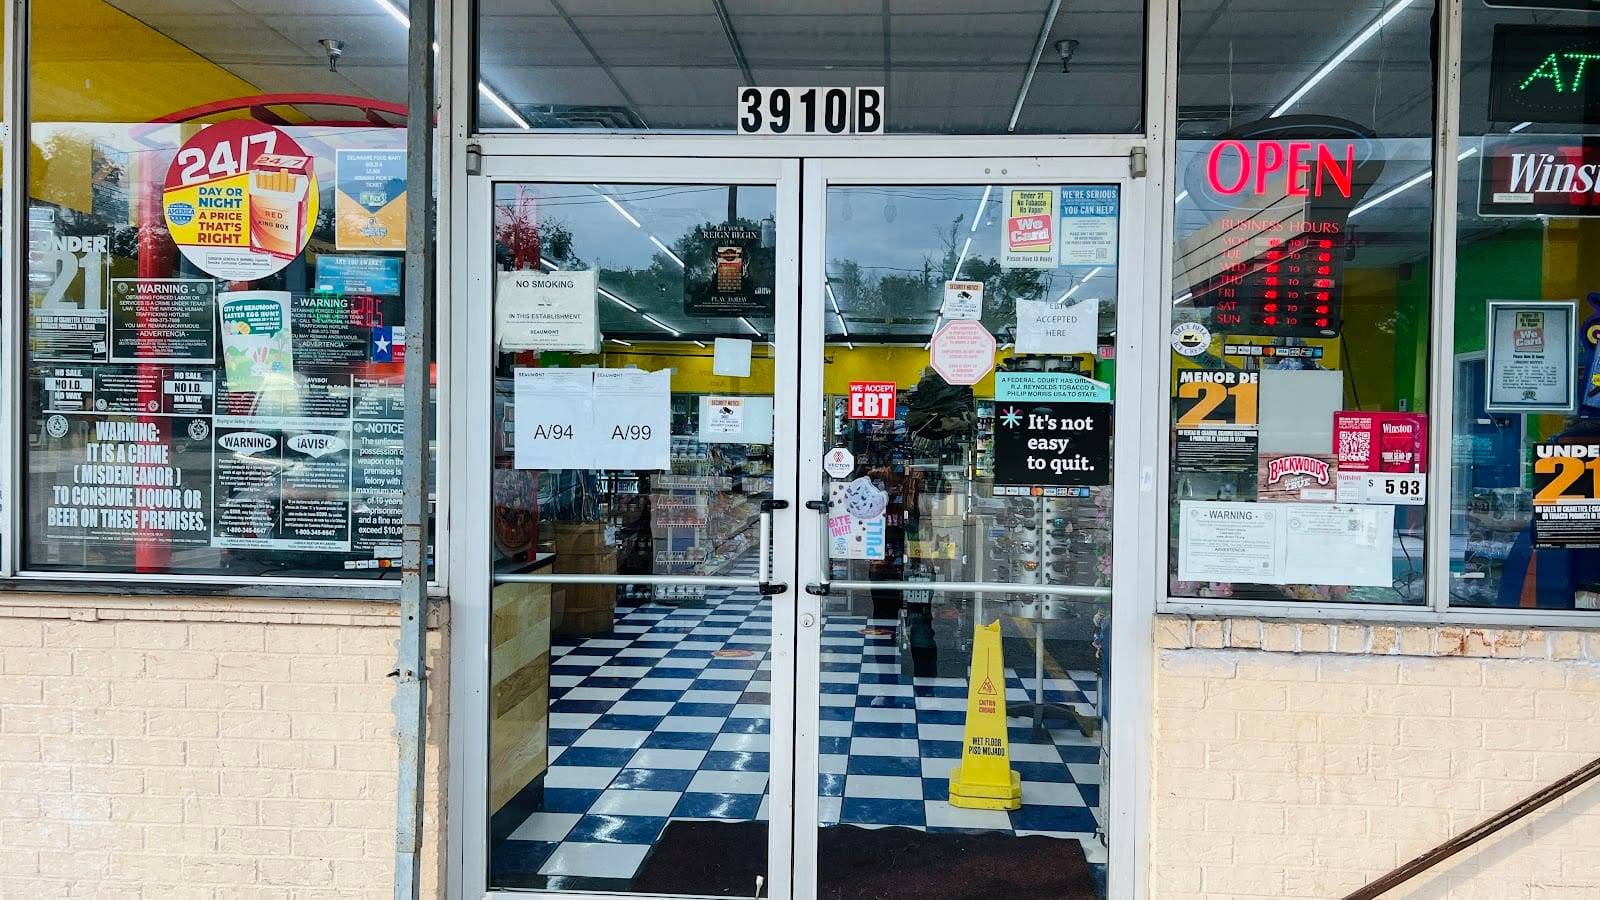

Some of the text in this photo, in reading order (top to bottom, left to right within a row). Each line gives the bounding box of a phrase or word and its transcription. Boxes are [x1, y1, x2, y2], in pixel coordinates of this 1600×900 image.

[741, 88, 881, 133] 3910 B
[177, 131, 277, 185] 24/7
[257, 155, 304, 167] 24/7
[1207, 139, 1354, 198] OPEN
[199, 187, 242, 196] DAY OR
[1063, 190, 1116, 198] WE'RE SERIOUS
[199, 198, 242, 208] NIGHT
[265, 211, 283, 219] RED
[1064, 206, 1114, 214] YOU CAN HELP
[199, 212, 242, 220] A PRICE
[198, 222, 242, 231] THAT'S
[1017, 218, 1043, 230] We
[1221, 219, 1340, 234] BUSINESS HOURS
[198, 233, 241, 243] RIGHT
[1011, 228, 1049, 242] Card
[1223, 250, 1241, 258] TUE
[1222, 263, 1246, 272] WED
[41, 251, 101, 309] 21
[1221, 276, 1243, 284] THU
[137, 284, 188, 293] WARNING
[1219, 289, 1234, 297] FRI
[300, 298, 348, 307] WARNING
[1217, 302, 1237, 310] SAT
[1217, 315, 1240, 323] SUN
[1516, 337, 1542, 346] Card
[185, 372, 202, 380] SALE.
[1180, 371, 1258, 383] MENOR DE
[56, 379, 82, 390] NO I.D.
[175, 383, 202, 392] NO I.D.
[55, 391, 82, 400] NO WAY.
[185, 395, 202, 403] WAY.
[852, 393, 893, 417] EBT
[1178, 382, 1258, 424] 21
[1028, 414, 1093, 430] It's not
[96, 422, 160, 442] WARNING:
[534, 424, 574, 440] A/94
[612, 425, 651, 440] A/99
[1383, 424, 1412, 433] Winston
[224, 437, 271, 448] WARNING
[1027, 438, 1069, 454] easy
[87, 443, 169, 464] IT IS A CRIME
[360, 448, 399, 456] possession
[1027, 454, 1094, 474] to quit.
[1269, 456, 1330, 483] BACKWOODS
[81, 465, 174, 486] MISDEMEANOR
[365, 478, 385, 486] felony
[53, 486, 201, 509] TO CONSUME LIQUOR OR
[48, 507, 78, 527] BEER
[81, 508, 98, 528] ON
[101, 509, 138, 528] THESE
[141, 510, 207, 531] PREMISES.
[1209, 510, 1252, 519] WARNING
[829, 515, 851, 528] BITE
[832, 525, 851, 537] IN!!!
[866, 519, 882, 556] PULL
[973, 737, 1001, 746] WET FLOOR
[969, 746, 1005, 756] PISO MOJADO
